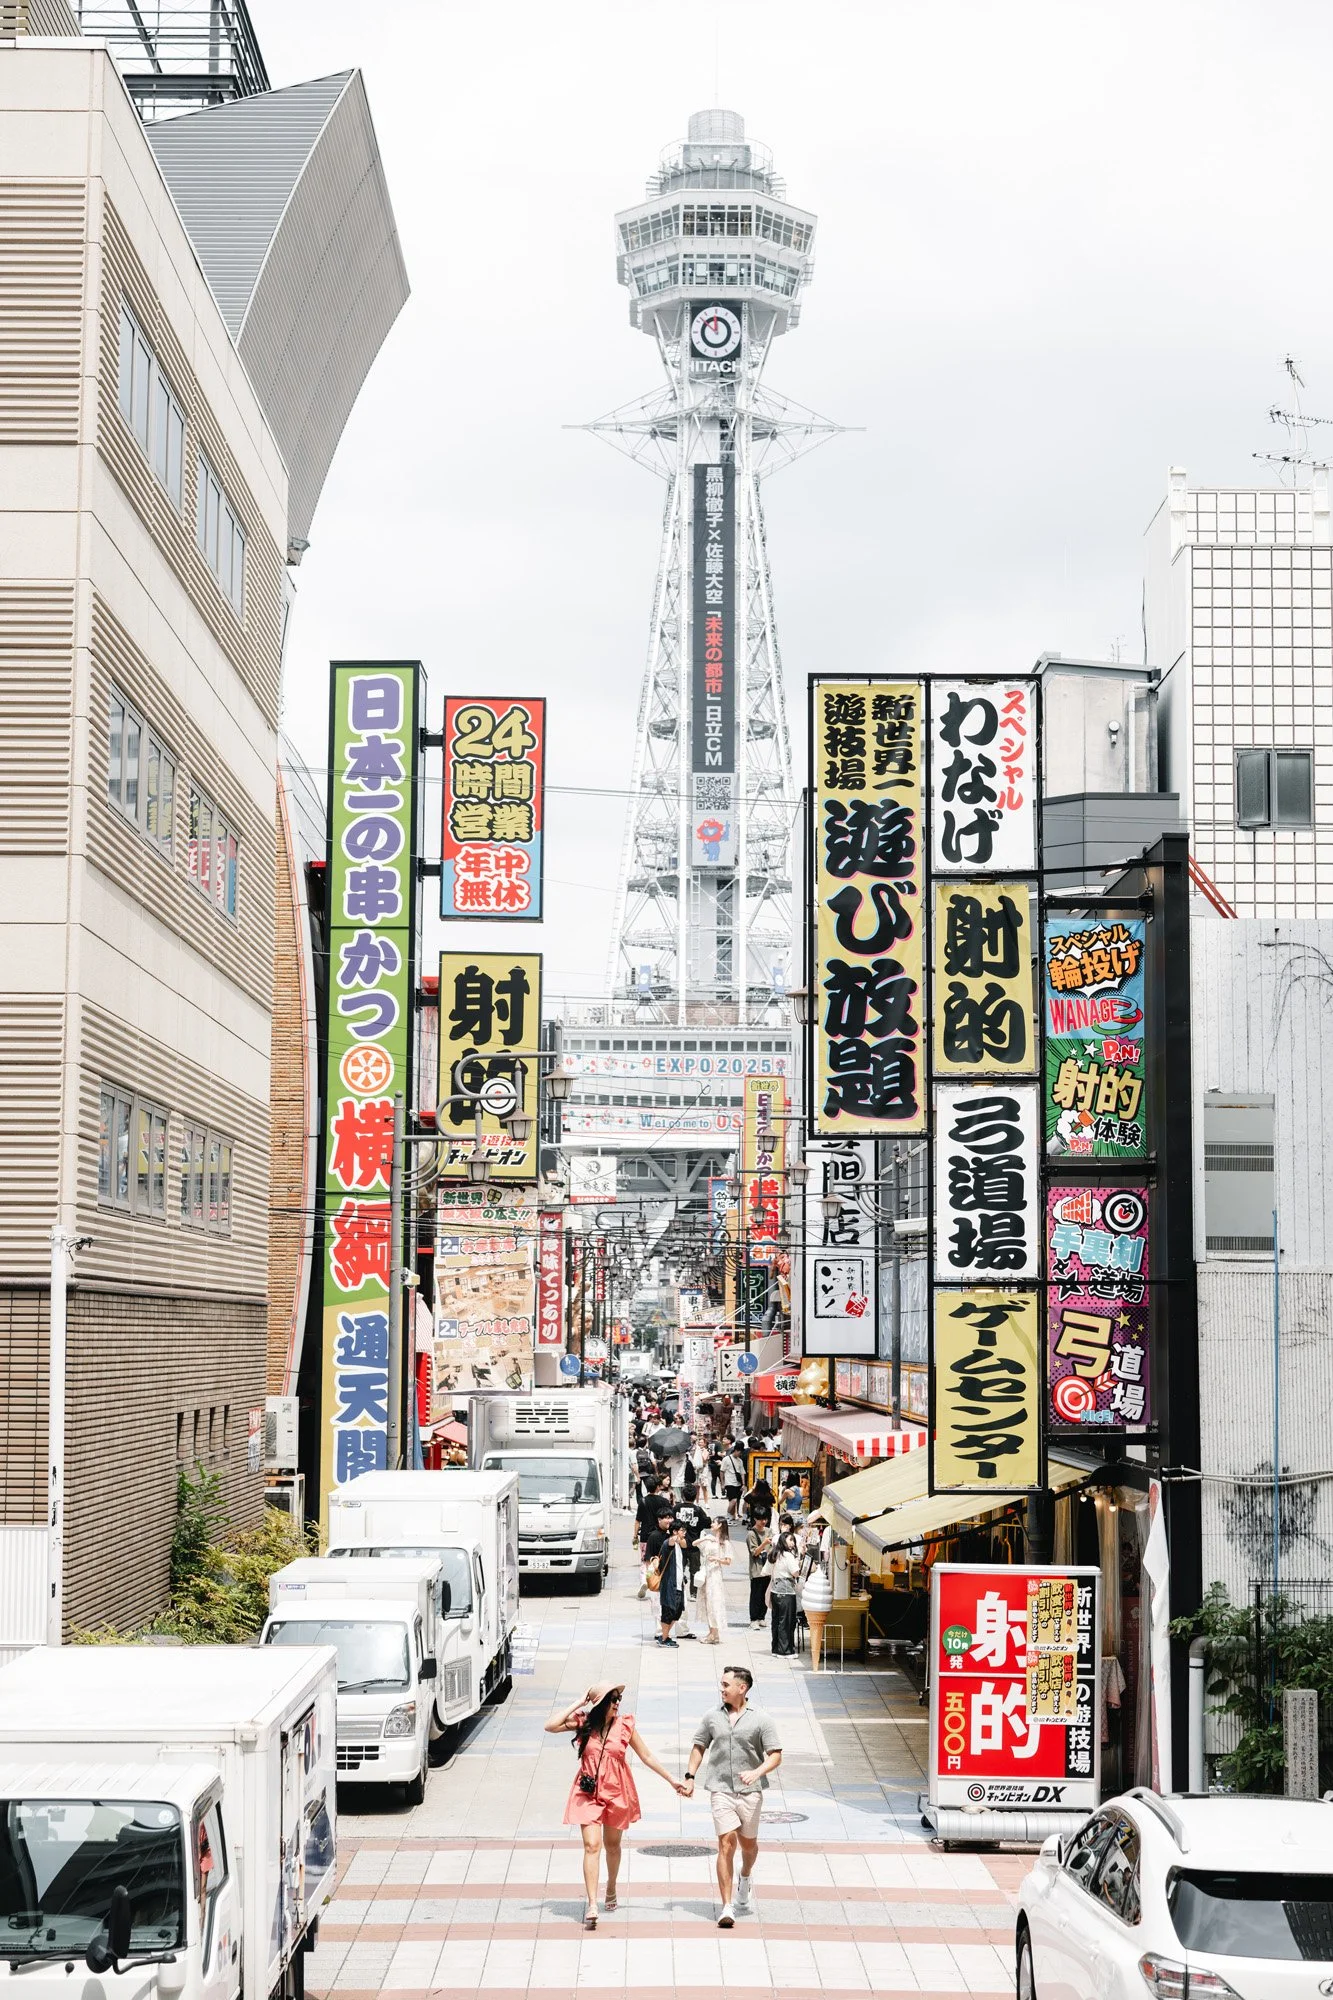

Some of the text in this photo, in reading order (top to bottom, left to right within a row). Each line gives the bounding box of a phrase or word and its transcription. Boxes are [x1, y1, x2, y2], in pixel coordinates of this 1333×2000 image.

[454, 705, 534, 758] 24
[823, 693, 867, 790] 遊技場
[871, 694, 917, 790] 新世界一
[996, 689, 1027, 810] スペシャル
[452, 760, 532, 800] 時間
[939, 691, 1003, 864] わなげ
[451, 801, 533, 842] 営業
[456, 849, 528, 877] 年中
[456, 878, 529, 909] 無休
[823, 797, 920, 1121] 遊び放題
[1049, 923, 1130, 956] スペシャル
[943, 893, 1026, 1064] 射的
[1048, 940, 1142, 991] 輪投げ
[1049, 998, 1121, 1035] WANAGE
[1101, 1039, 1140, 1063] PAN!
[1052, 1058, 1144, 1121] 射的
[1092, 1116, 1143, 1149] 体験
[443, 1191, 483, 1205] 新世界
[1050, 1223, 1145, 1273] 手裏剣
[1088, 1268, 1145, 1303] 道場
[1054, 1309, 1114, 1379] 弓
[944, 1299, 1031, 1479] ゲームセンター
[1111, 1343, 1145, 1421] 道場
[950, 1655, 963, 1670] 発
[987, 1786, 1067, 1803] チャンピオン DX
